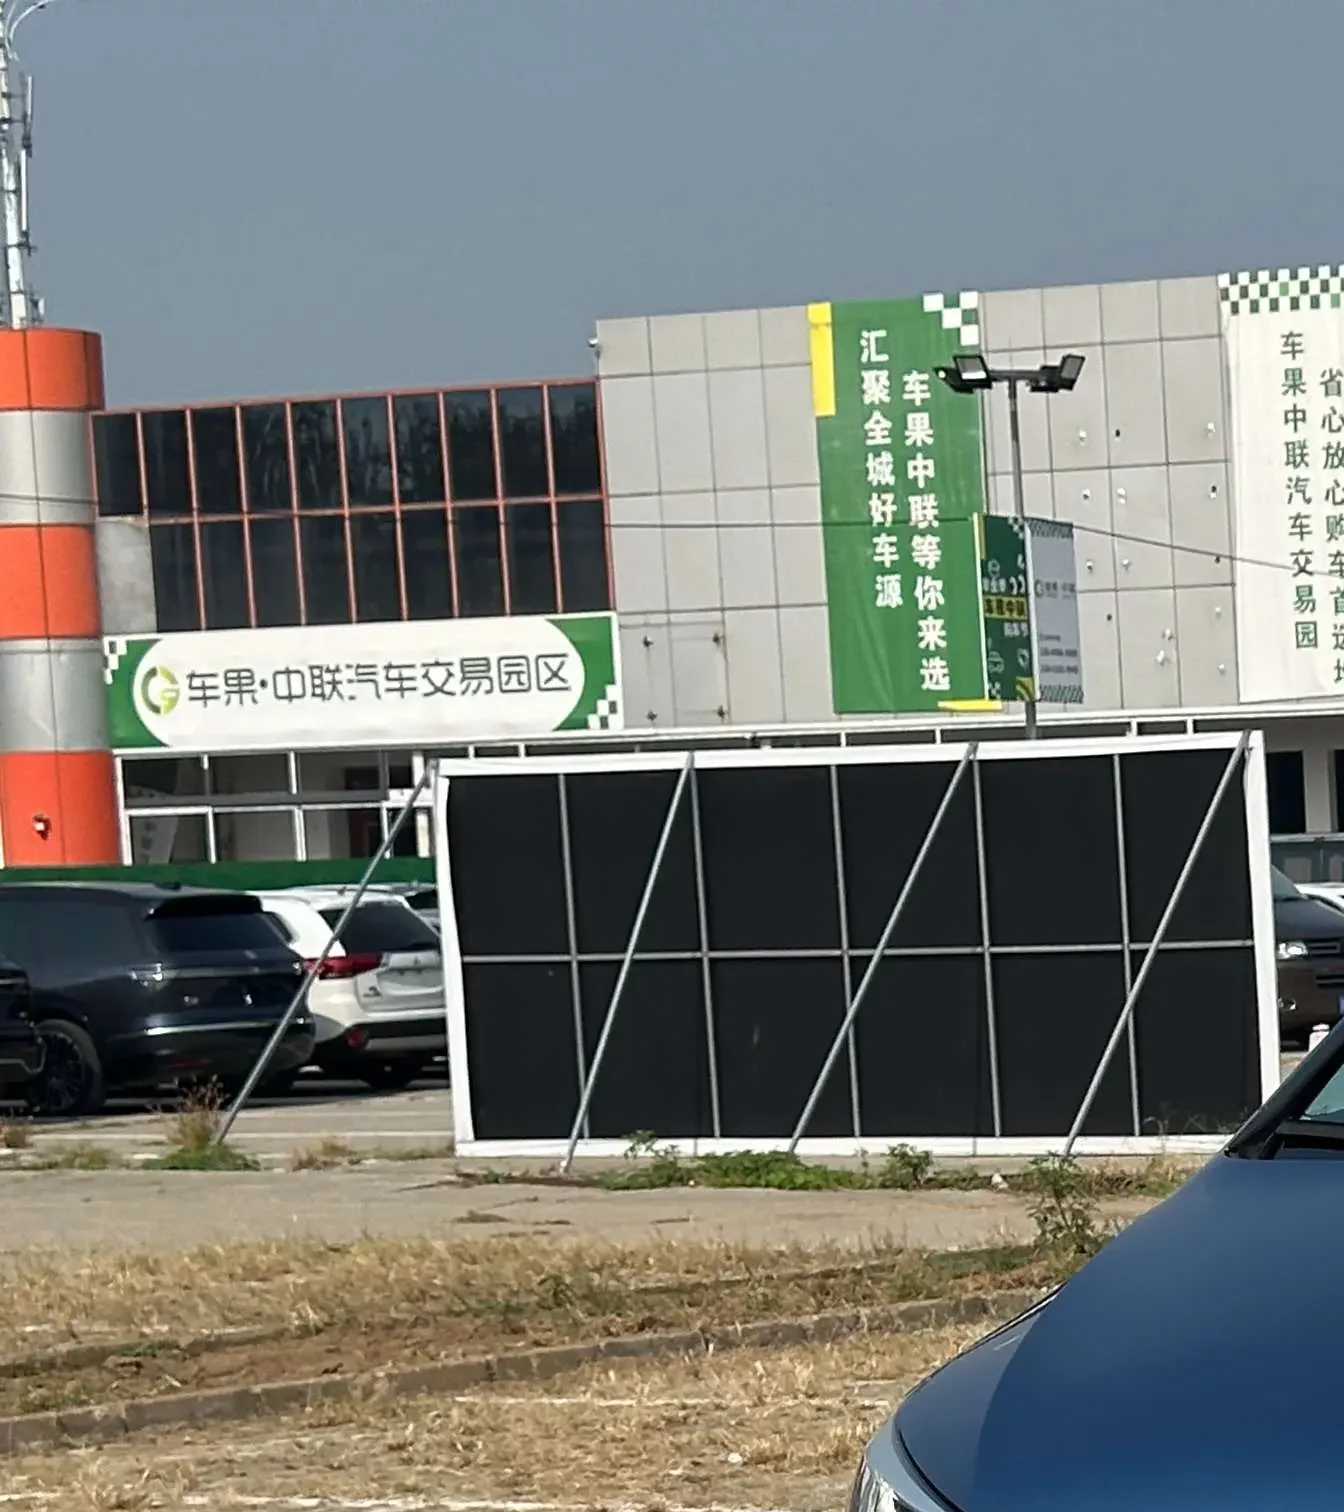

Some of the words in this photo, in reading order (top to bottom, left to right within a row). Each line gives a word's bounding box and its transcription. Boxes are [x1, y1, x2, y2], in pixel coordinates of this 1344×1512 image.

[859, 329, 903, 609] 汇聚全城好车源
[902, 369, 951, 691] 车果中联等你来选
[1279, 330, 1319, 649] 车果中联汽车交易园
[186, 653, 571, 707] 车果·中联汽车交易园区
